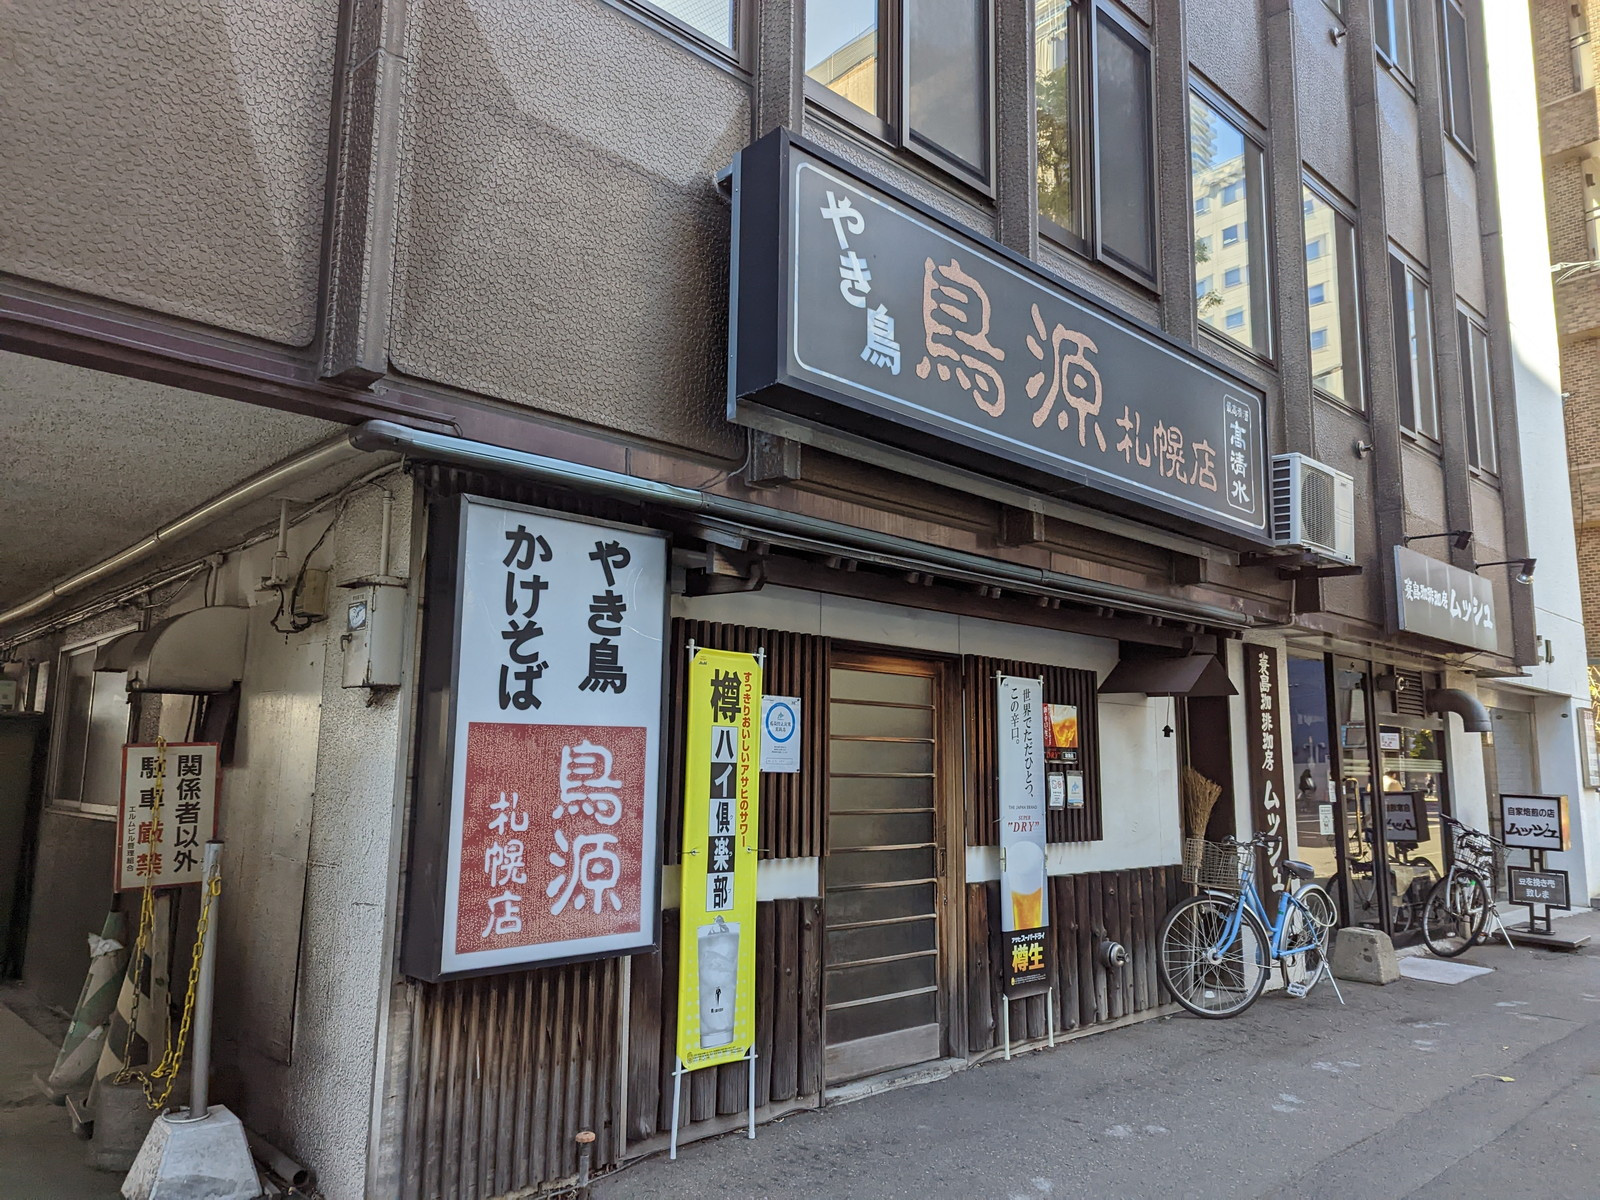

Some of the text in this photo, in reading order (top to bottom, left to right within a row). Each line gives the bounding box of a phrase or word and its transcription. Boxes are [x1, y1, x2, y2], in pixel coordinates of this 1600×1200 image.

[819, 190, 902, 376] やき鳥
[915, 256, 1218, 493] 鳥源 札幌店
[498, 524, 553, 711] かけそば
[578, 540, 632, 695] やき鳥
[1450, 588, 1493, 630] ムッシュ
[739, 671, 752, 848] すっきりおいしいアサヒのサワー
[1010, 688, 1020, 745] この辛口。
[1022, 688, 1035, 797] 世界でただひとつ、
[126, 806, 136, 872] エルムビル管理組合
[173, 754, 203, 873] 関係者以外
[546, 739, 623, 916] 鳥源
[710, 668, 742, 909] 樽ハイ倶楽部
[1263, 779, 1285, 893] ムッシュ
[1505, 822, 1560, 839] ムッシュ
[1507, 806, 1555, 818] 自家焙煎の店
[482, 790, 529, 938] 札幌店
[1011, 942, 1045, 974] 樽生
